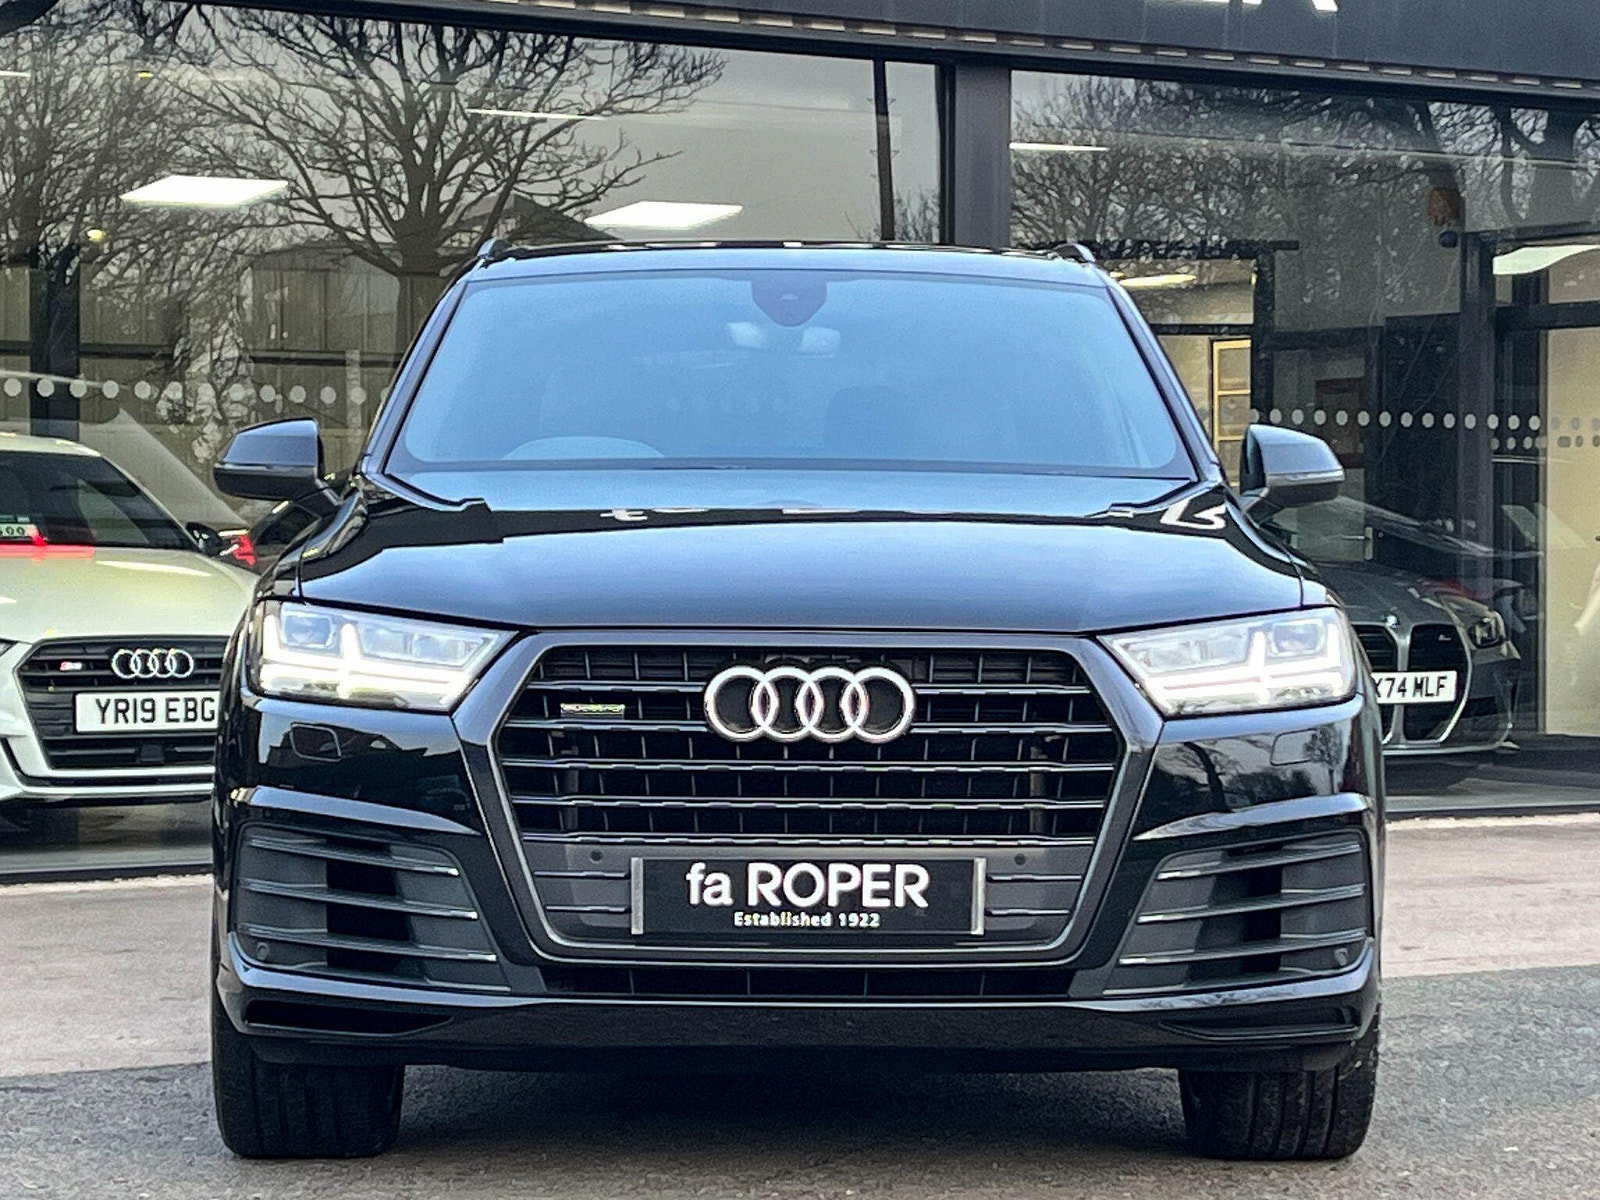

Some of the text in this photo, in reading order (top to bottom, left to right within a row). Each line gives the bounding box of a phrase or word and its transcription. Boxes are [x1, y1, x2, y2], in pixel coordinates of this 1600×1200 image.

[1412, 676, 1448, 698] MLF
[95, 697, 215, 725] YR19 EBG
[686, 862, 930, 908] fa ROPER
[734, 911, 881, 928] Established 1922
